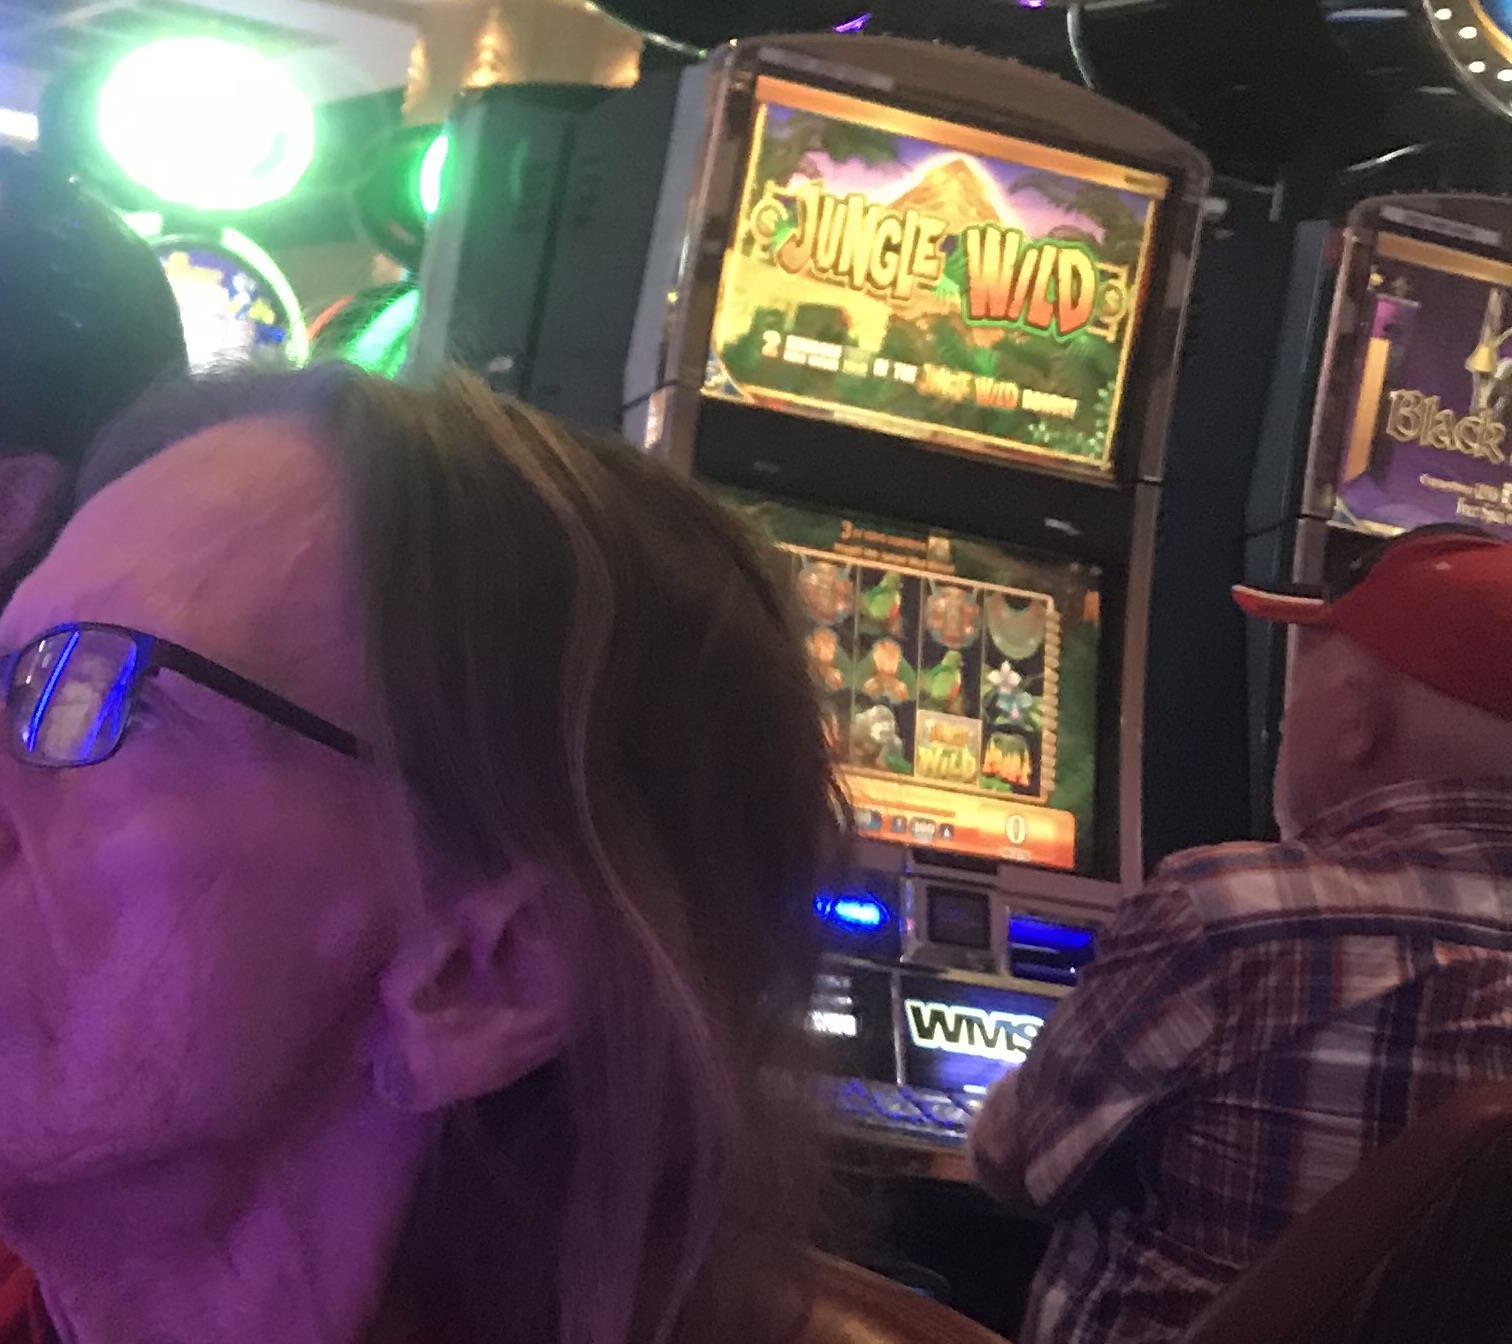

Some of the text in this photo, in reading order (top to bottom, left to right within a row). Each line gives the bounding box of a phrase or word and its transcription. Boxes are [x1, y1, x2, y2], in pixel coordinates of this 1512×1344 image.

[777, 183, 1098, 335] JUNGLE WILD
[1386, 389, 1505, 464] Black
[908, 1002, 1042, 1060] WMS
